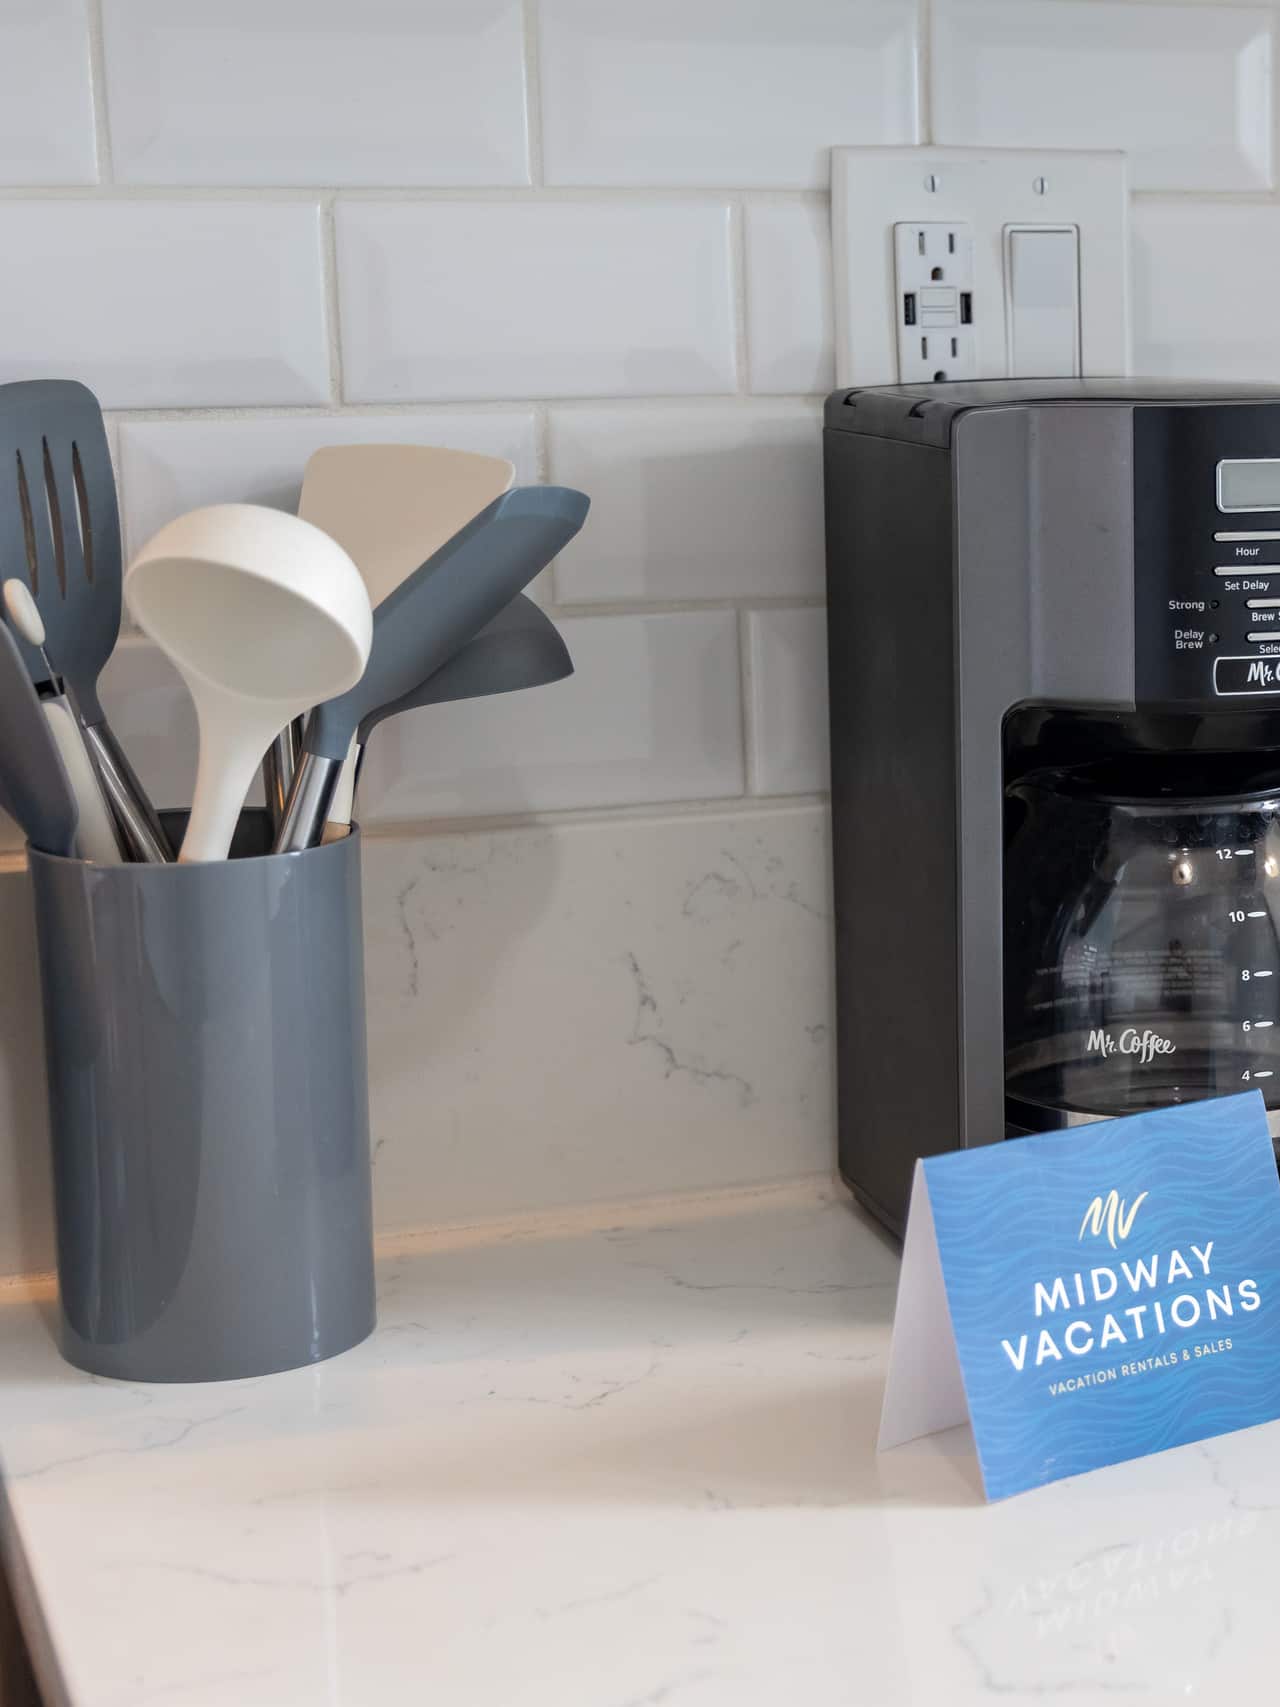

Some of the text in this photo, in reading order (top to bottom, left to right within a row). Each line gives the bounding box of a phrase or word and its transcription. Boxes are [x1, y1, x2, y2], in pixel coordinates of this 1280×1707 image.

[1235, 547, 1260, 556] Hour
[1224, 580, 1270, 591] Set Delay
[1168, 600, 1205, 612] Strong
[1251, 612, 1275, 621] Brew
[1174, 629, 1204, 640] Delay
[1175, 640, 1203, 649] Brew
[1247, 661, 1274, 686] Mr.
[1216, 848, 1232, 860] 12
[1228, 910, 1245, 922] 10
[1241, 969, 1250, 981] 8
[1241, 1020, 1250, 1032] 6
[1086, 1028, 1176, 1064] Mr. Coffee
[1241, 1069, 1250, 1081] 4
[1033, 1241, 1214, 1317] MIDWAY
[1001, 1279, 1262, 1371] VACATIONS
[1049, 1338, 1233, 1396] VACATION RENTALS & SALES
